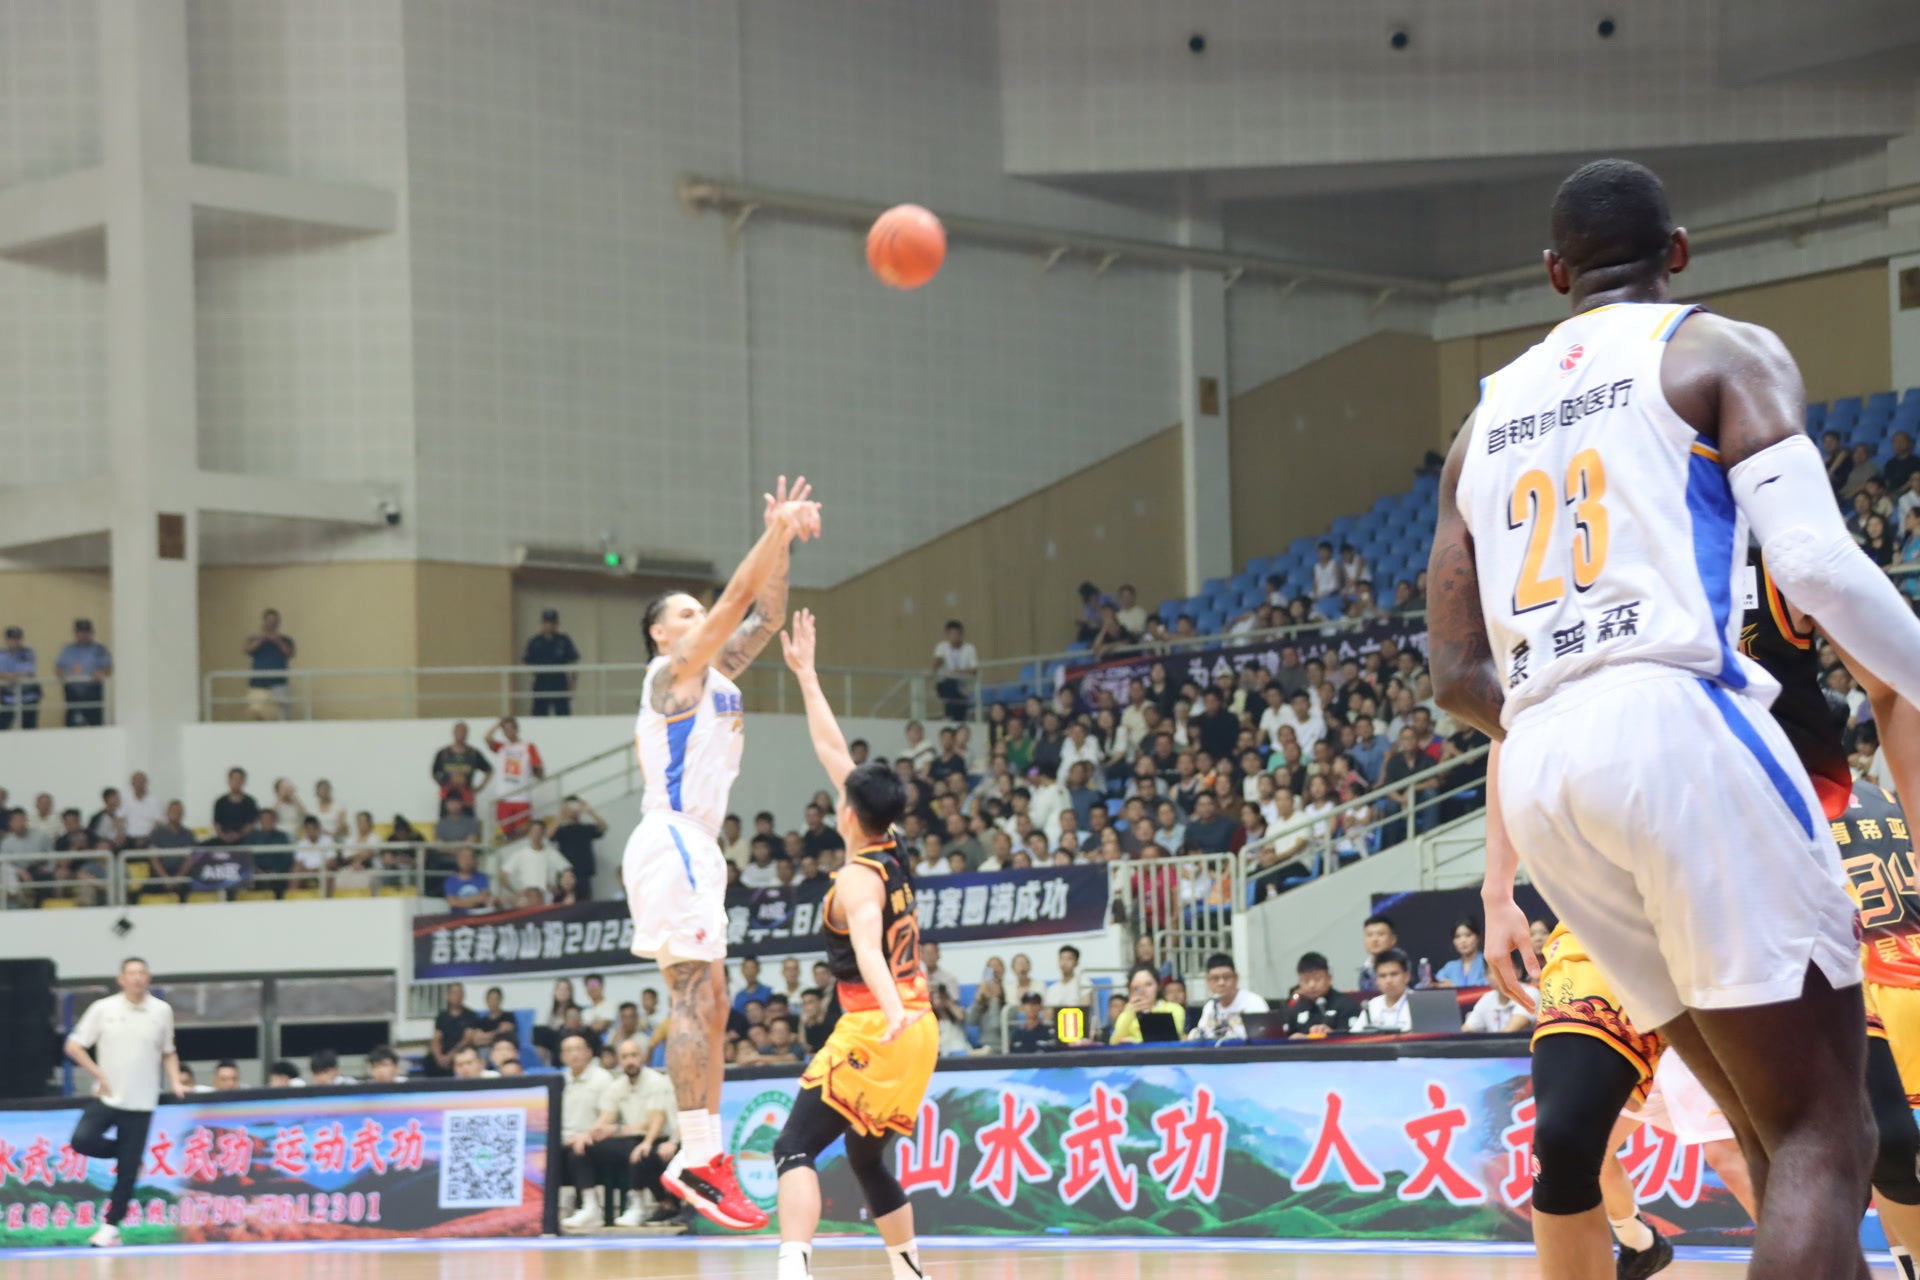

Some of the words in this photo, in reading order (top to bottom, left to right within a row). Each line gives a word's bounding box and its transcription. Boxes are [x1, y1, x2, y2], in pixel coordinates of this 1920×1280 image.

[1488, 378, 1634, 455] 首钢首颐医疗
[1507, 448, 1610, 616] 23
[272, 1118, 425, 1176] 运动武功
[898, 1083, 1227, 1209] 山水武功
